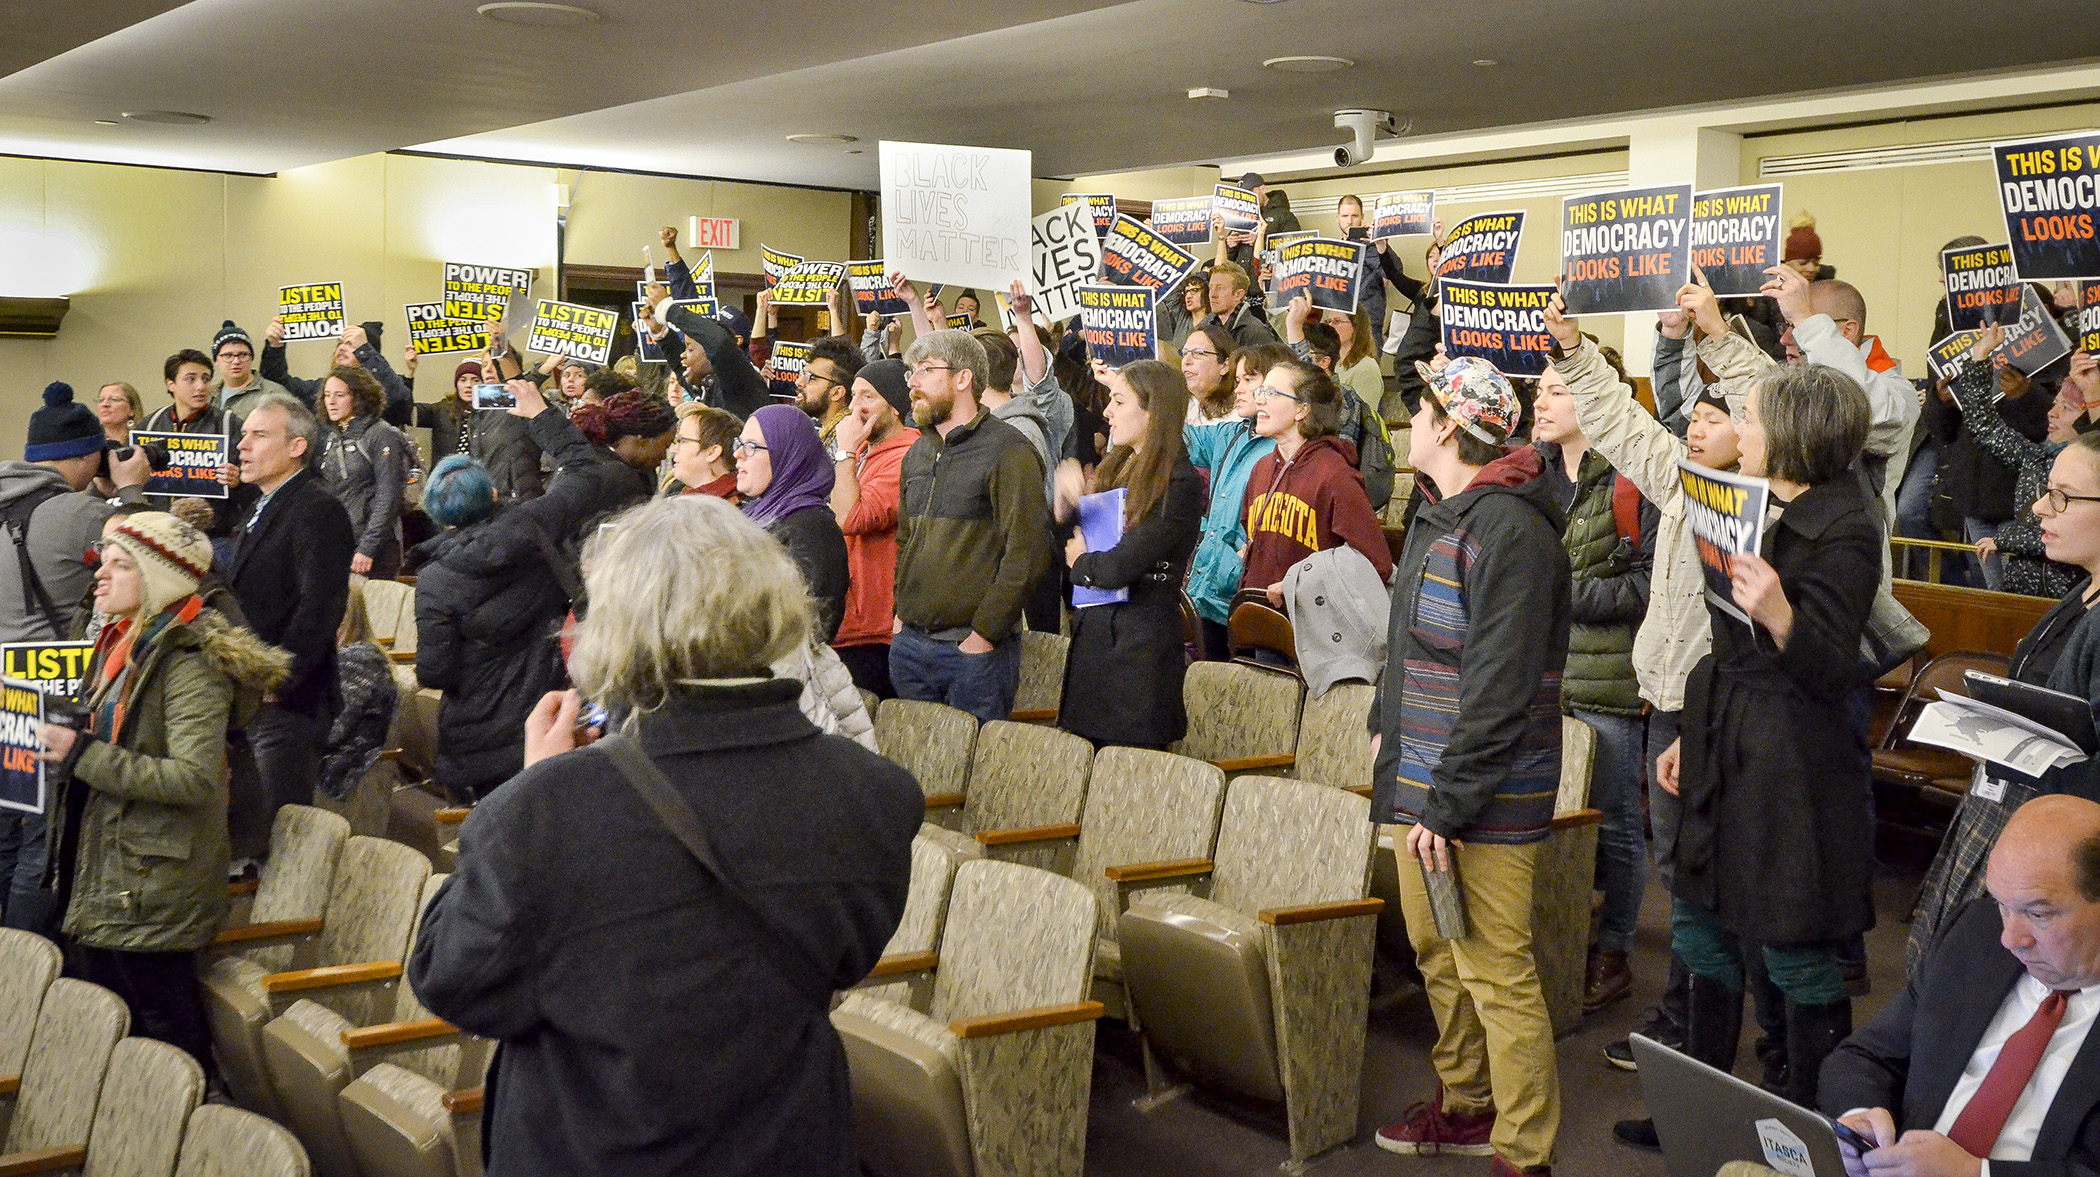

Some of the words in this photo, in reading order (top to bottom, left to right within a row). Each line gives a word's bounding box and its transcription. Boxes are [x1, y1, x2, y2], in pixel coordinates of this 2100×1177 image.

[895, 152, 990, 190] BLACK
[2006, 149, 2056, 176] THIS
[2060, 146, 2082, 172] IS
[1088, 197, 1110, 205] WHAT
[1219, 188, 1234, 198] THIS
[1234, 190, 1241, 199] IS
[1241, 192, 1256, 203] WHAT
[1377, 196, 1392, 208] THIS
[1393, 196, 1401, 204] IS
[1402, 194, 1430, 202] WHAT
[2004, 174, 2100, 213] DEMOC
[896, 189, 968, 230] LIVES
[1158, 203, 1176, 212] THIS
[1177, 202, 1186, 210] IS
[1186, 200, 1209, 210] WHAT
[1216, 196, 1258, 214] DEMOCRACY
[1375, 202, 1432, 220] DEMOCRACY
[1568, 202, 1598, 225] THIS
[1600, 200, 1616, 220] IS
[1620, 194, 1679, 218] WHAT
[1692, 200, 1709, 218] HIS
[1711, 198, 1724, 216] IS
[1726, 194, 1771, 215] WHAT
[1094, 218, 1110, 226] LIKE
[1154, 209, 1212, 224] DEMOCRACY
[1242, 211, 1258, 220] LIKE
[1376, 216, 1402, 228] LOOKS
[1405, 214, 1426, 223] LIKE
[701, 219, 733, 246] EXIT
[1032, 206, 1087, 248] ACK
[1157, 223, 1184, 233] LOOKS
[1187, 222, 1206, 231] LIKE
[1447, 226, 1462, 244] THIS
[1462, 222, 1472, 235] IS
[1474, 216, 1516, 232] WHAT
[1691, 215, 1777, 245] EMOCRACY
[2021, 214, 2094, 242] LOOKS
[1441, 230, 1518, 263] DEMOCRACY
[1564, 218, 1686, 257] DEMOCRACY
[896, 228, 1020, 270] MATTER
[1135, 232, 1152, 246] IS
[1150, 239, 1188, 267] WHAT
[1282, 244, 1301, 261] THIS
[1301, 243, 1314, 255] IS
[1315, 244, 1356, 260] WHAT
[1691, 247, 1725, 267] OOKS
[1732, 244, 1766, 265] LIKE
[771, 254, 777, 263] IS
[777, 255, 799, 267] WHAT
[791, 264, 843, 276] OWER
[863, 265, 870, 275] IS
[870, 264, 884, 274] WH
[1033, 238, 1095, 287] VES
[1275, 256, 1359, 279] DEMOCRACY
[1436, 255, 1467, 279] LOOKS
[1471, 251, 1505, 267] LIKE
[1568, 257, 1620, 281] LOOKS
[1628, 252, 1672, 276] LIKE
[1952, 252, 1984, 270] THIS
[1986, 250, 1999, 266] IS
[447, 265, 528, 288] POWER
[806, 274, 839, 283] PEOPLE
[1102, 252, 1132, 274] OOKS
[1132, 270, 1164, 292] LIKE
[1948, 265, 2016, 292] DEMOCRA
[447, 281, 460, 290] TO
[462, 282, 482, 292] THE
[484, 284, 526, 296] PEOP
[696, 285, 707, 294] AT
[1278, 273, 1311, 292] LOOKS
[1316, 275, 1348, 292] LIKE
[280, 285, 341, 305] LISTEN
[446, 291, 484, 302] PEOPLE
[486, 295, 507, 305] THE
[878, 289, 899, 300] LIK
[1007, 273, 1096, 325] ATTE
[1081, 291, 1099, 306] THIS
[1100, 292, 1110, 307] IS
[1111, 293, 1146, 307] WHAT
[1447, 286, 1478, 304] THIS
[1482, 291, 1496, 306] IS
[1498, 292, 1549, 308] WHAT
[1957, 289, 2003, 308] LOOKS
[2005, 286, 2020, 303] LIKE
[288, 303, 304, 313] THE
[304, 300, 342, 312] PEOPLE
[307, 311, 327, 321] THE
[328, 310, 343, 320] TO
[446, 300, 503, 321] STEN
[538, 303, 614, 329] LISTEN
[683, 303, 710, 315] HAT
[411, 321, 426, 330] TO
[426, 319, 447, 328] THE
[537, 317, 550, 325] TO
[551, 320, 571, 330] THE
[571, 323, 610, 338] PEOPLE
[1082, 307, 1152, 330] DEMOCRACY
[1444, 303, 1545, 332] DEMOCRAC
[412, 328, 451, 339] PEOPLE
[452, 326, 473, 336] THE
[474, 324, 489, 333] TO
[534, 326, 572, 340] PEOPLE
[571, 332, 592, 344] THE
[1086, 328, 1114, 346] LOOKS
[1118, 331, 1147, 347] LIKE
[413, 332, 490, 352] LISTEN
[531, 334, 606, 362] POWER
[593, 337, 607, 347] TO
[1452, 329, 1503, 349] LOOKS
[1510, 334, 1552, 352] LIKE
[1938, 334, 1974, 360] THIS
[2011, 328, 2047, 357] LIKE
[777, 346, 794, 357] THIS
[795, 347, 803, 358] IS
[771, 356, 806, 372] DEMOC
[776, 371, 800, 382] LOOK
[167, 438, 180, 449] IS
[181, 438, 219, 451] WHAT
[168, 450, 224, 467] CRACY
[188, 468, 216, 480] LIKE
[1706, 481, 1748, 517] WHAT
[6, 648, 95, 679] LIST
[6, 688, 38, 714] WHAT
[4, 746, 36, 774] LIKE
[1763, 1136, 1808, 1166] ITASCA
